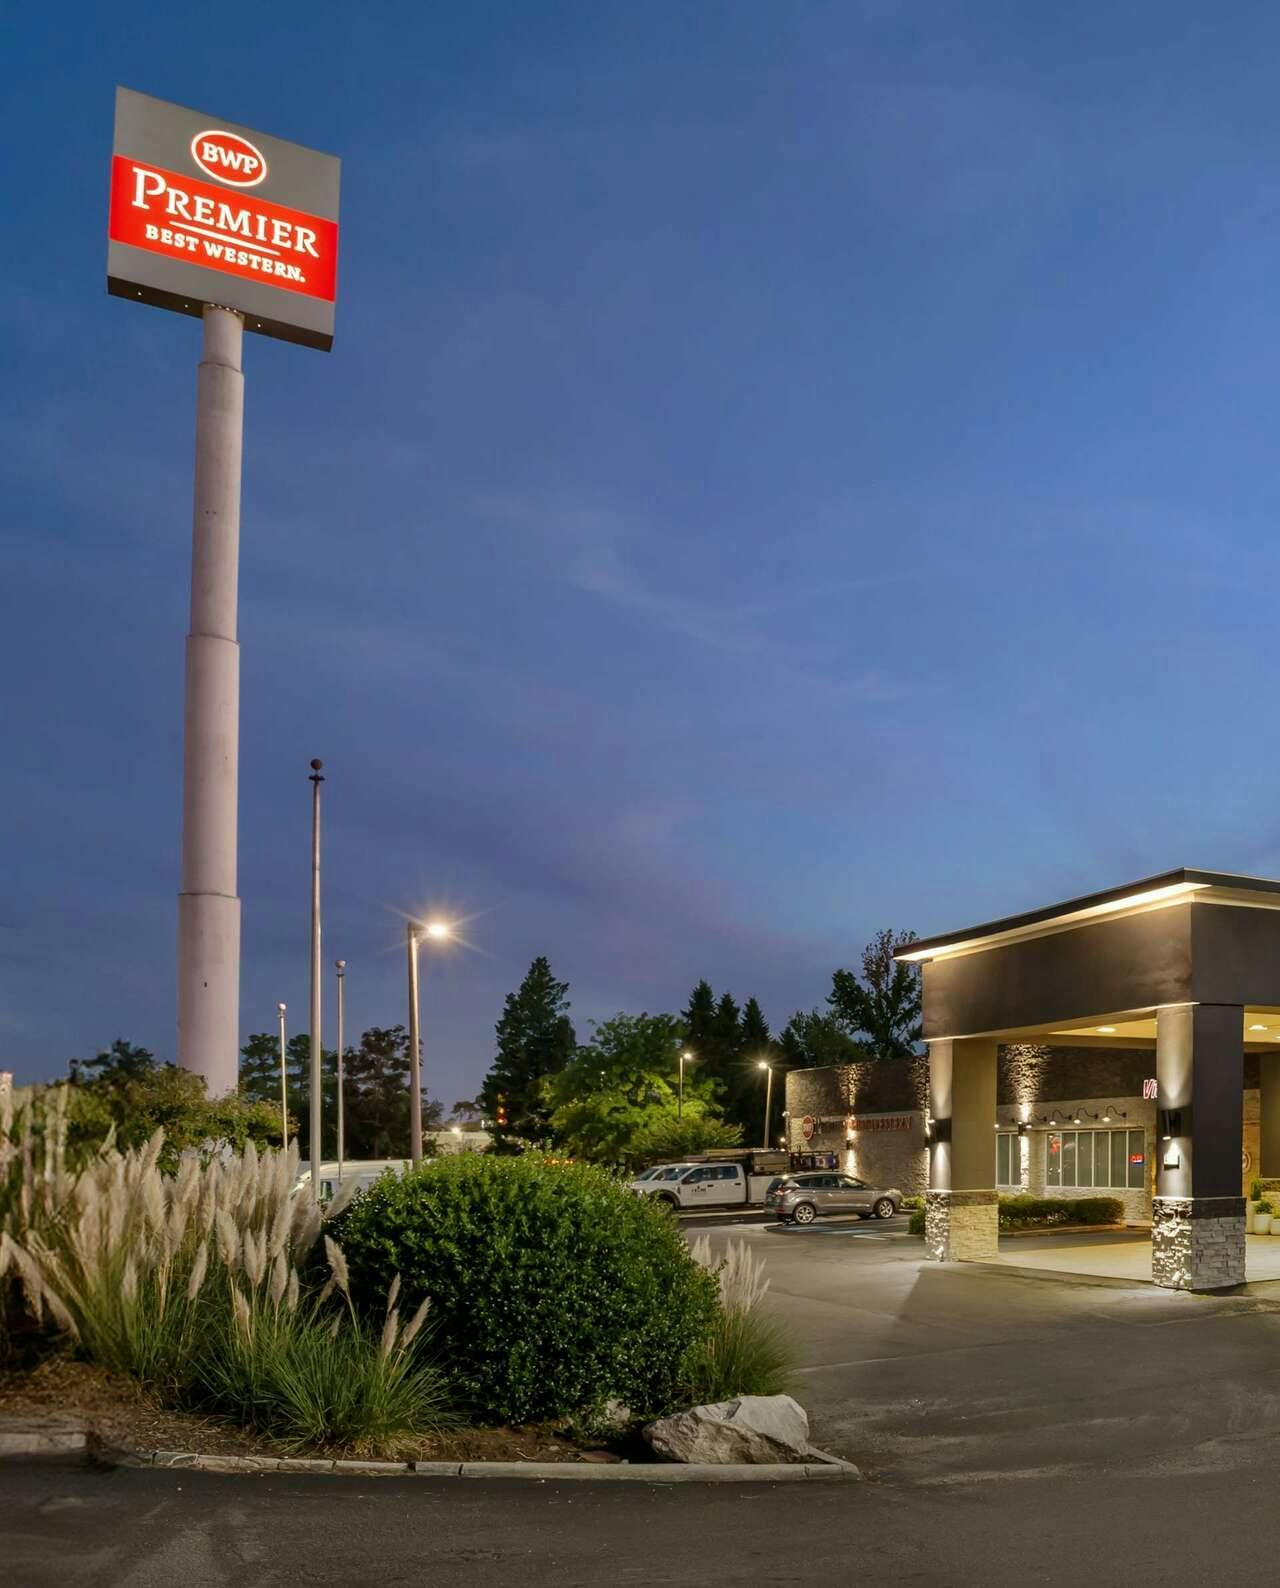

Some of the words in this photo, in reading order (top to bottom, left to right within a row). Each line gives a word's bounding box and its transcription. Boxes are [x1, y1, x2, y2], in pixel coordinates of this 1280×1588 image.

[202, 141, 259, 175] BWP
[131, 166, 321, 258] PREMIER
[145, 224, 199, 252] BEST
